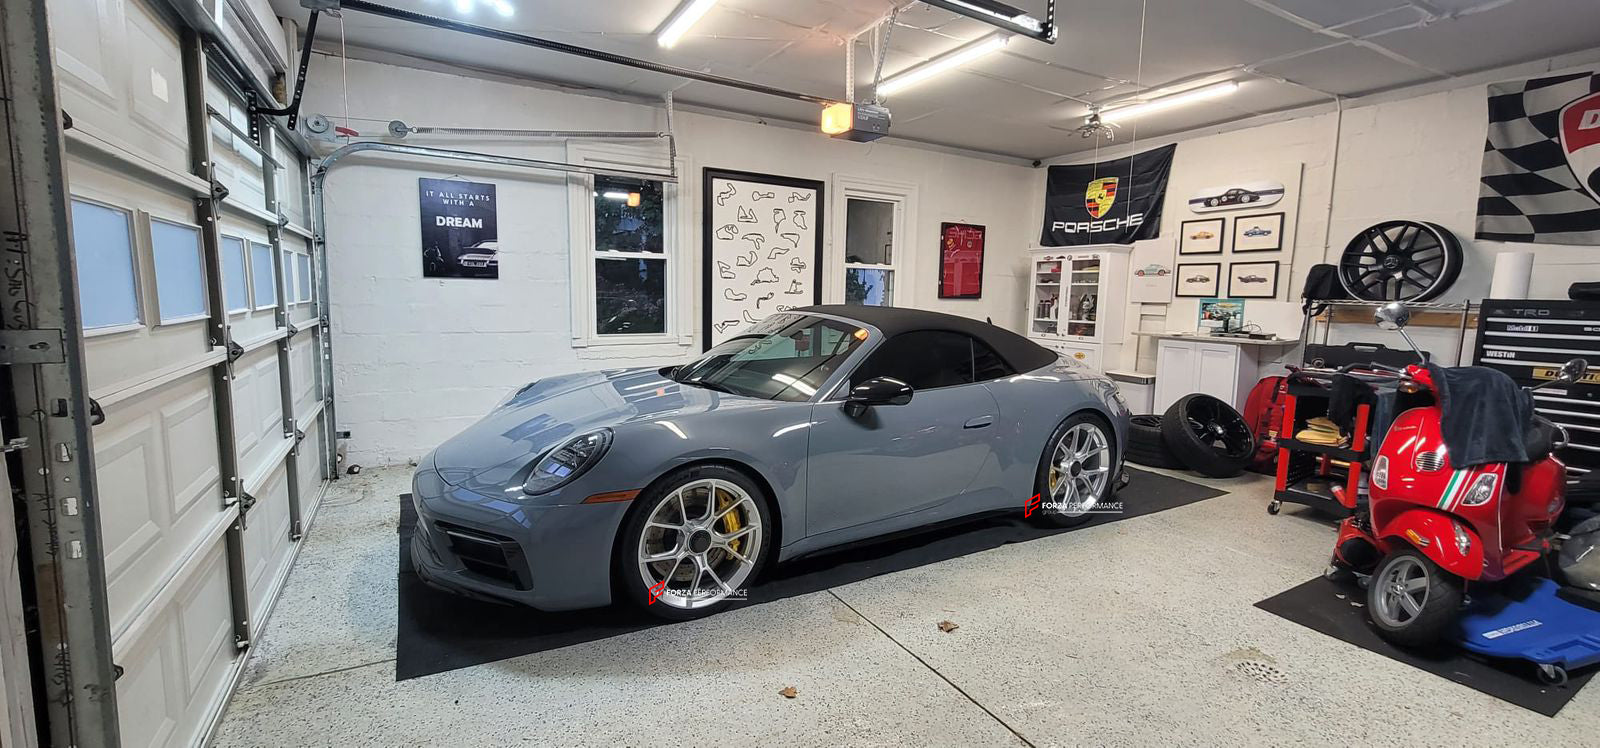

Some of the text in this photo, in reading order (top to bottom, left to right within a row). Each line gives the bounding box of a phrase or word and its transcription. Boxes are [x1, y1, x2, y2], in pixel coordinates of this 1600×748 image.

[425, 190, 490, 202] IT ALL STARTS
[442, 198, 465, 206] WITH
[435, 215, 483, 229] DREAM
[1052, 213, 1144, 234] PORSCHE
[1512, 308, 1550, 317] TRD
